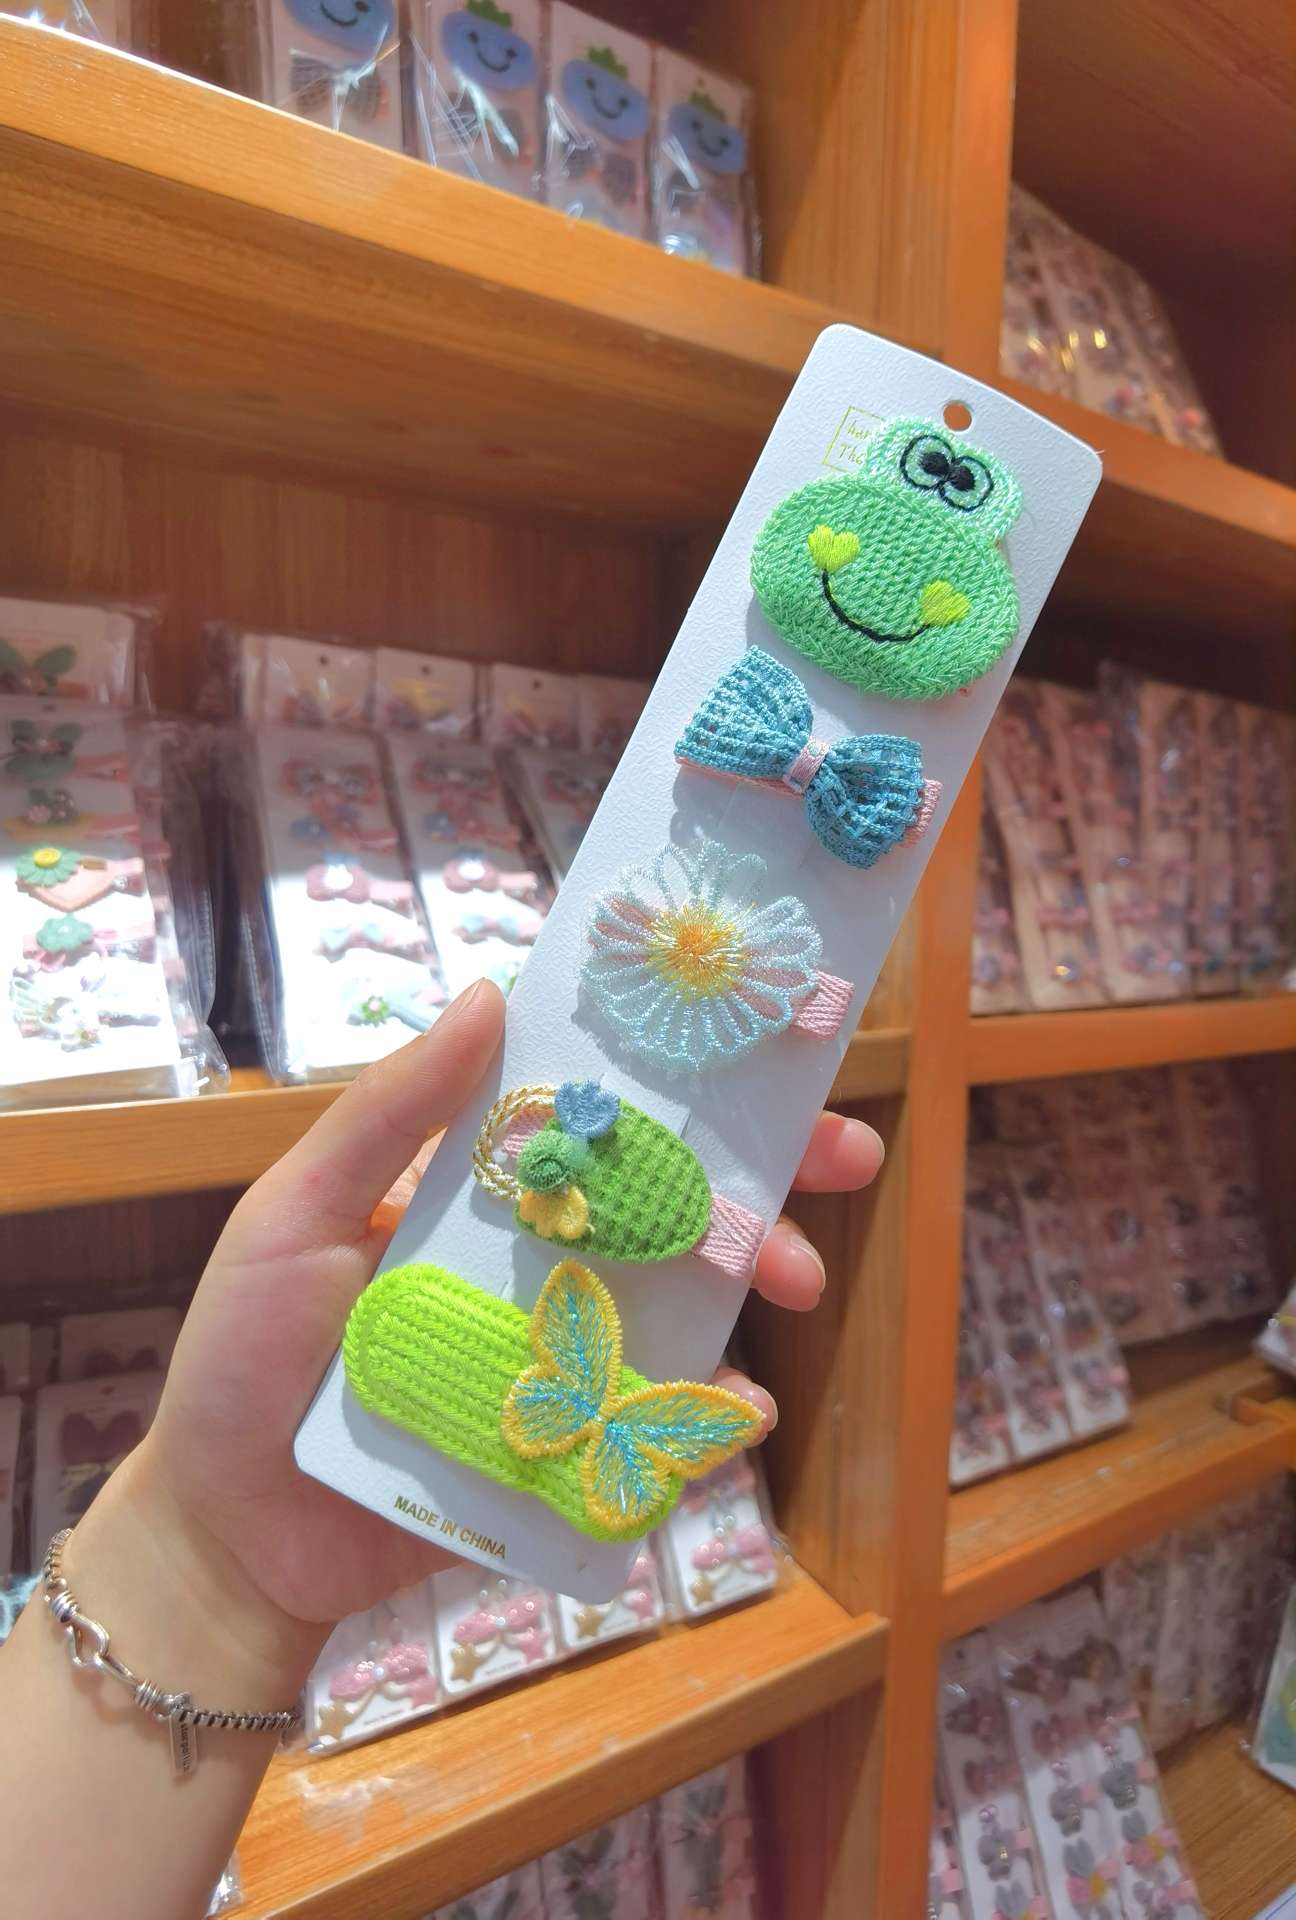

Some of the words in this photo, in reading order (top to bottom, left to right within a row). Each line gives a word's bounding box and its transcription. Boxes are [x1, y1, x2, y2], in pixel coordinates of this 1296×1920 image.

[393, 1495, 439, 1527] MADE
[440, 1518, 458, 1537] IN
[459, 1527, 507, 1559] CHINA
